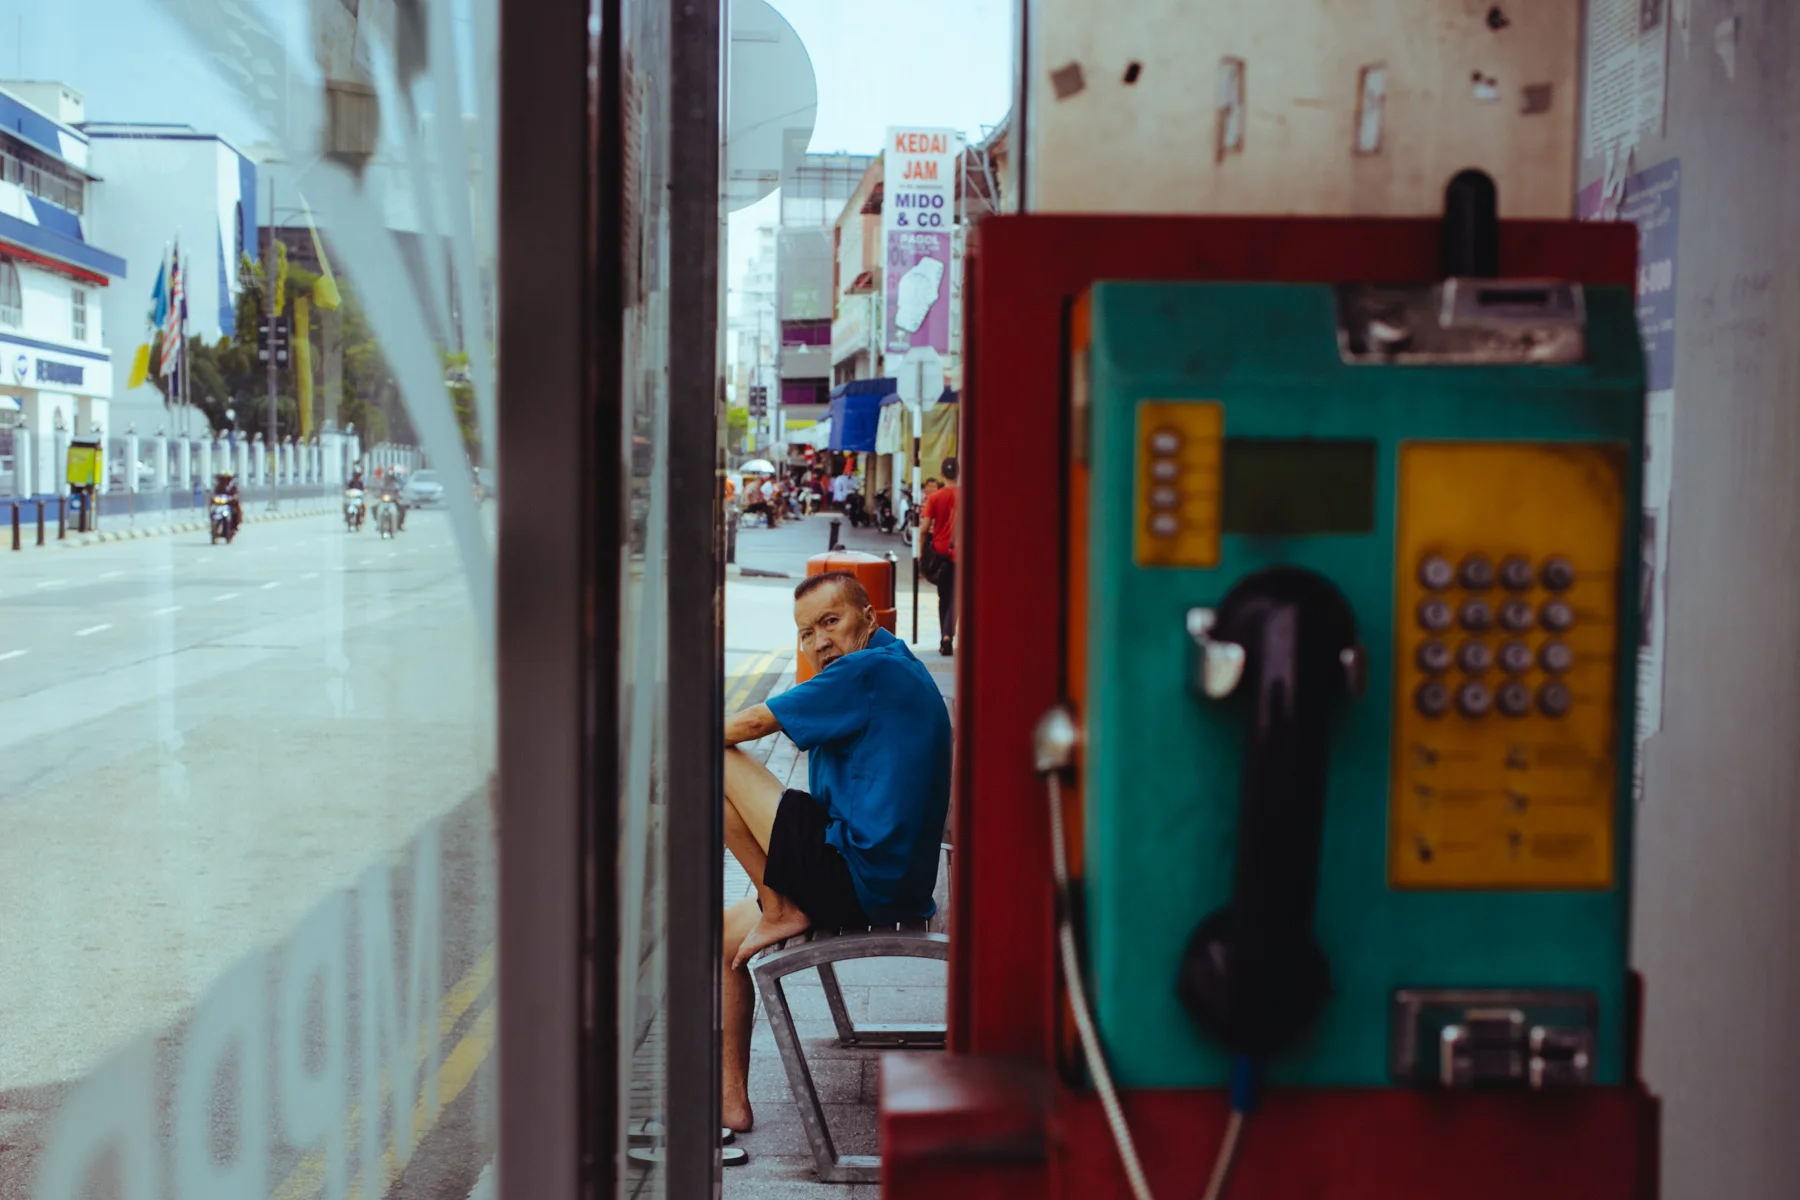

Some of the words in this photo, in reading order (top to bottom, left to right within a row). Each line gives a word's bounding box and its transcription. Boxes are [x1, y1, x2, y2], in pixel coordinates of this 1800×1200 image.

[895, 133, 947, 154] KEDAI
[903, 160, 938, 180] JAM
[895, 193, 944, 209] MIDO
[897, 212, 909, 227] &
